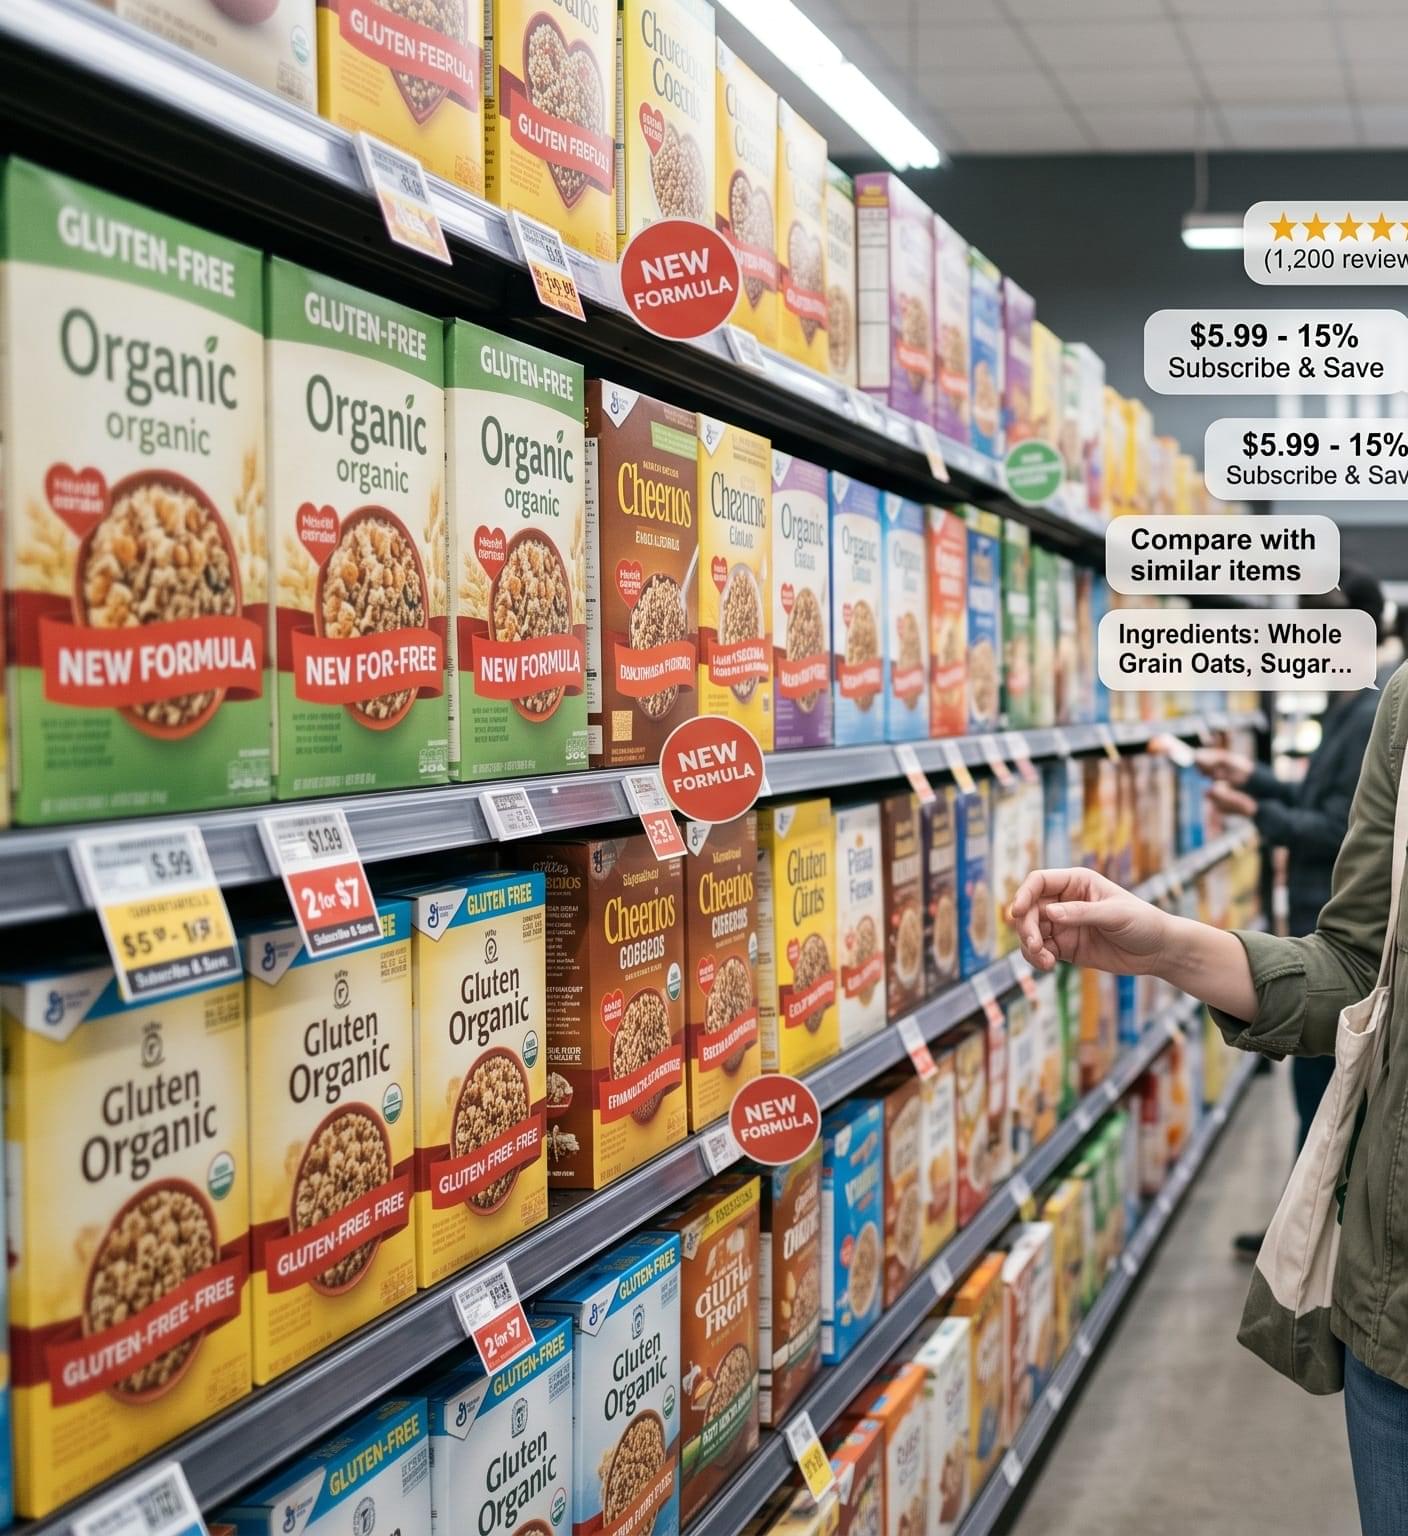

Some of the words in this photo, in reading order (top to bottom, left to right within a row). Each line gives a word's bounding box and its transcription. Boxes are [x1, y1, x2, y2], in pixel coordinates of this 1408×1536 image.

[350, 9, 416, 58] GLUTEN
[518, 113, 577, 153] GLUTEN
[57, 206, 236, 298] GLUTEN-FREE
[640, 247, 711, 284] NEW
[633, 275, 733, 311] FORMULA
[304, 292, 427, 361] GLUTEN-FREE
[60, 307, 238, 411] Organic
[480, 345, 574, 402] GLUTEN-FREE
[105, 410, 211, 456] organic
[306, 374, 427, 456] Organic
[481, 415, 574, 485] Organic
[337, 458, 409, 495] organic
[618, 462, 691, 529] Cheerios
[504, 487, 560, 519] organic
[781, 502, 824, 547] Organic
[58, 648, 134, 688] NEW
[139, 635, 256, 682] FORMULA
[356, 645, 437, 682] FOR-FREE
[481, 655, 517, 682] NEW
[521, 649, 581, 681] FORMULA
[672, 761, 756, 794] FORMULA
[677, 739, 737, 773] NEW
[787, 847, 826, 886] Gluten
[301, 887, 322, 919] 2
[335, 876, 360, 909] $7
[467, 888, 505, 916] GLUTEN
[507, 882, 532, 904] FREE
[699, 871, 754, 915] Cheerios
[604, 893, 676, 945] Cheerios
[461, 967, 519, 1005] Gluten
[304, 1010, 378, 1057] Gluten
[449, 991, 529, 1047] Organic
[289, 1036, 391, 1104] Organic
[102, 1068, 200, 1127] Gluten
[744, 1094, 797, 1121] NEW
[81, 1100, 217, 1183] Organic
[740, 1112, 814, 1142] FORMULA
[619, 1248, 675, 1300] GLUTEN-FREE
[484, 1335, 498, 1359] 2
[507, 1316, 522, 1341] $7
[612, 1331, 661, 1383] Gluten
[493, 1331, 566, 1397] GLUTEN-FREE
[604, 1355, 668, 1422] Organic
[329, 1413, 420, 1496] GLUTEN-FREE
[486, 1431, 548, 1493] Gluten
[478, 1454, 557, 1536] Organic
